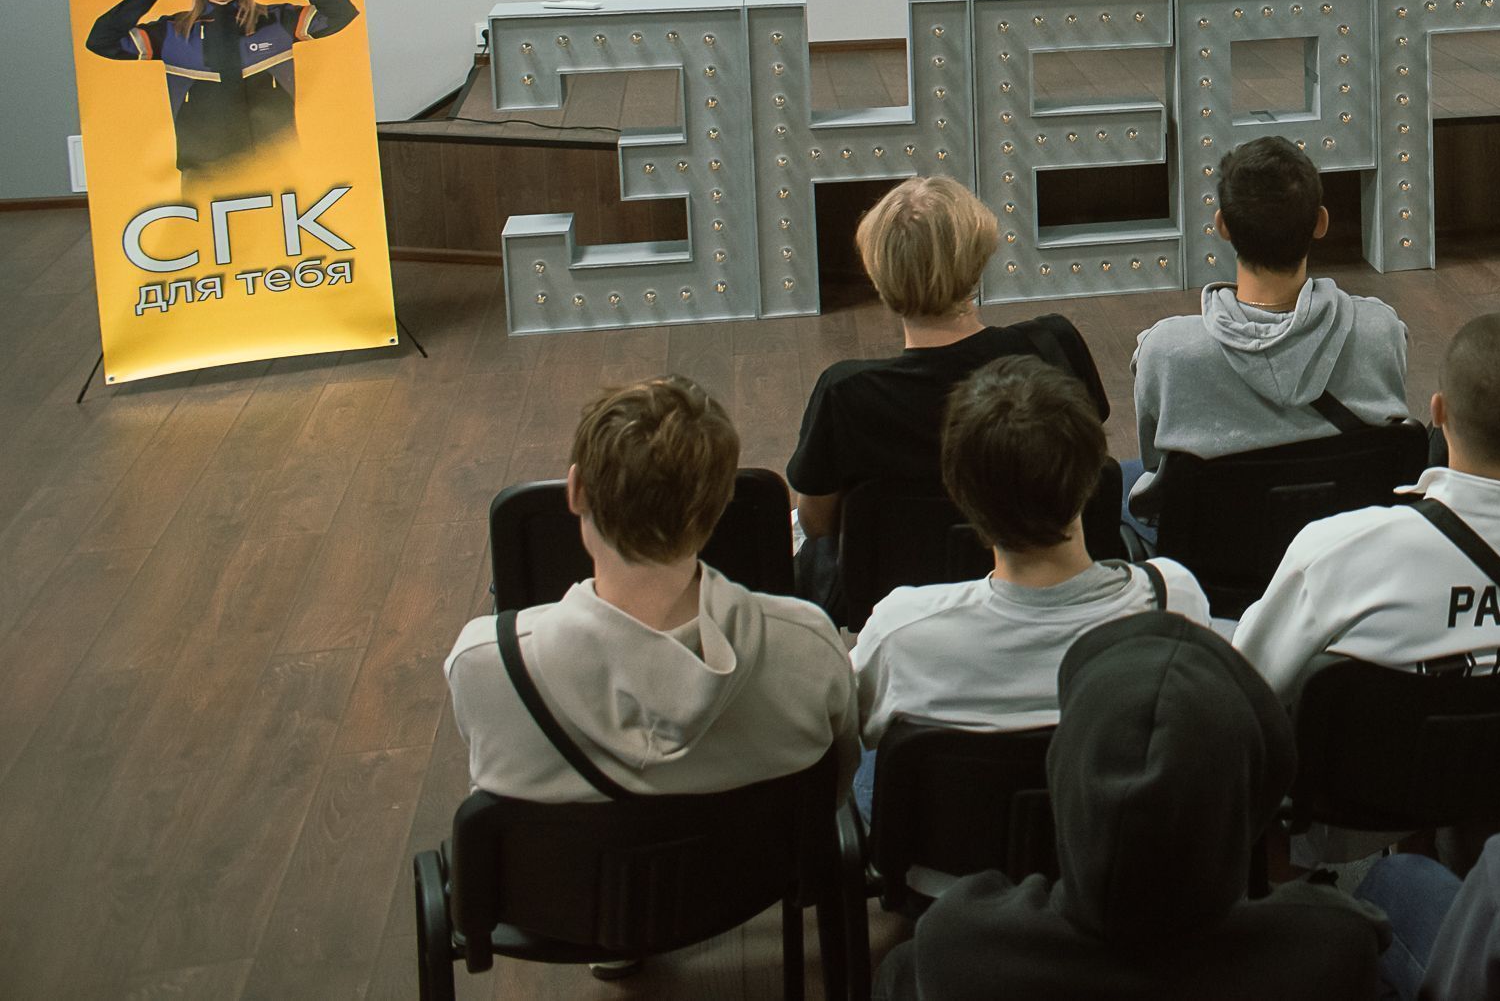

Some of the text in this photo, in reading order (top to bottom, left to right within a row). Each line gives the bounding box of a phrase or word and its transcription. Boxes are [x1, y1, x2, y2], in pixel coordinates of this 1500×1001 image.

[122, 185, 356, 272] СГК
[135, 258, 354, 316] для тебя
